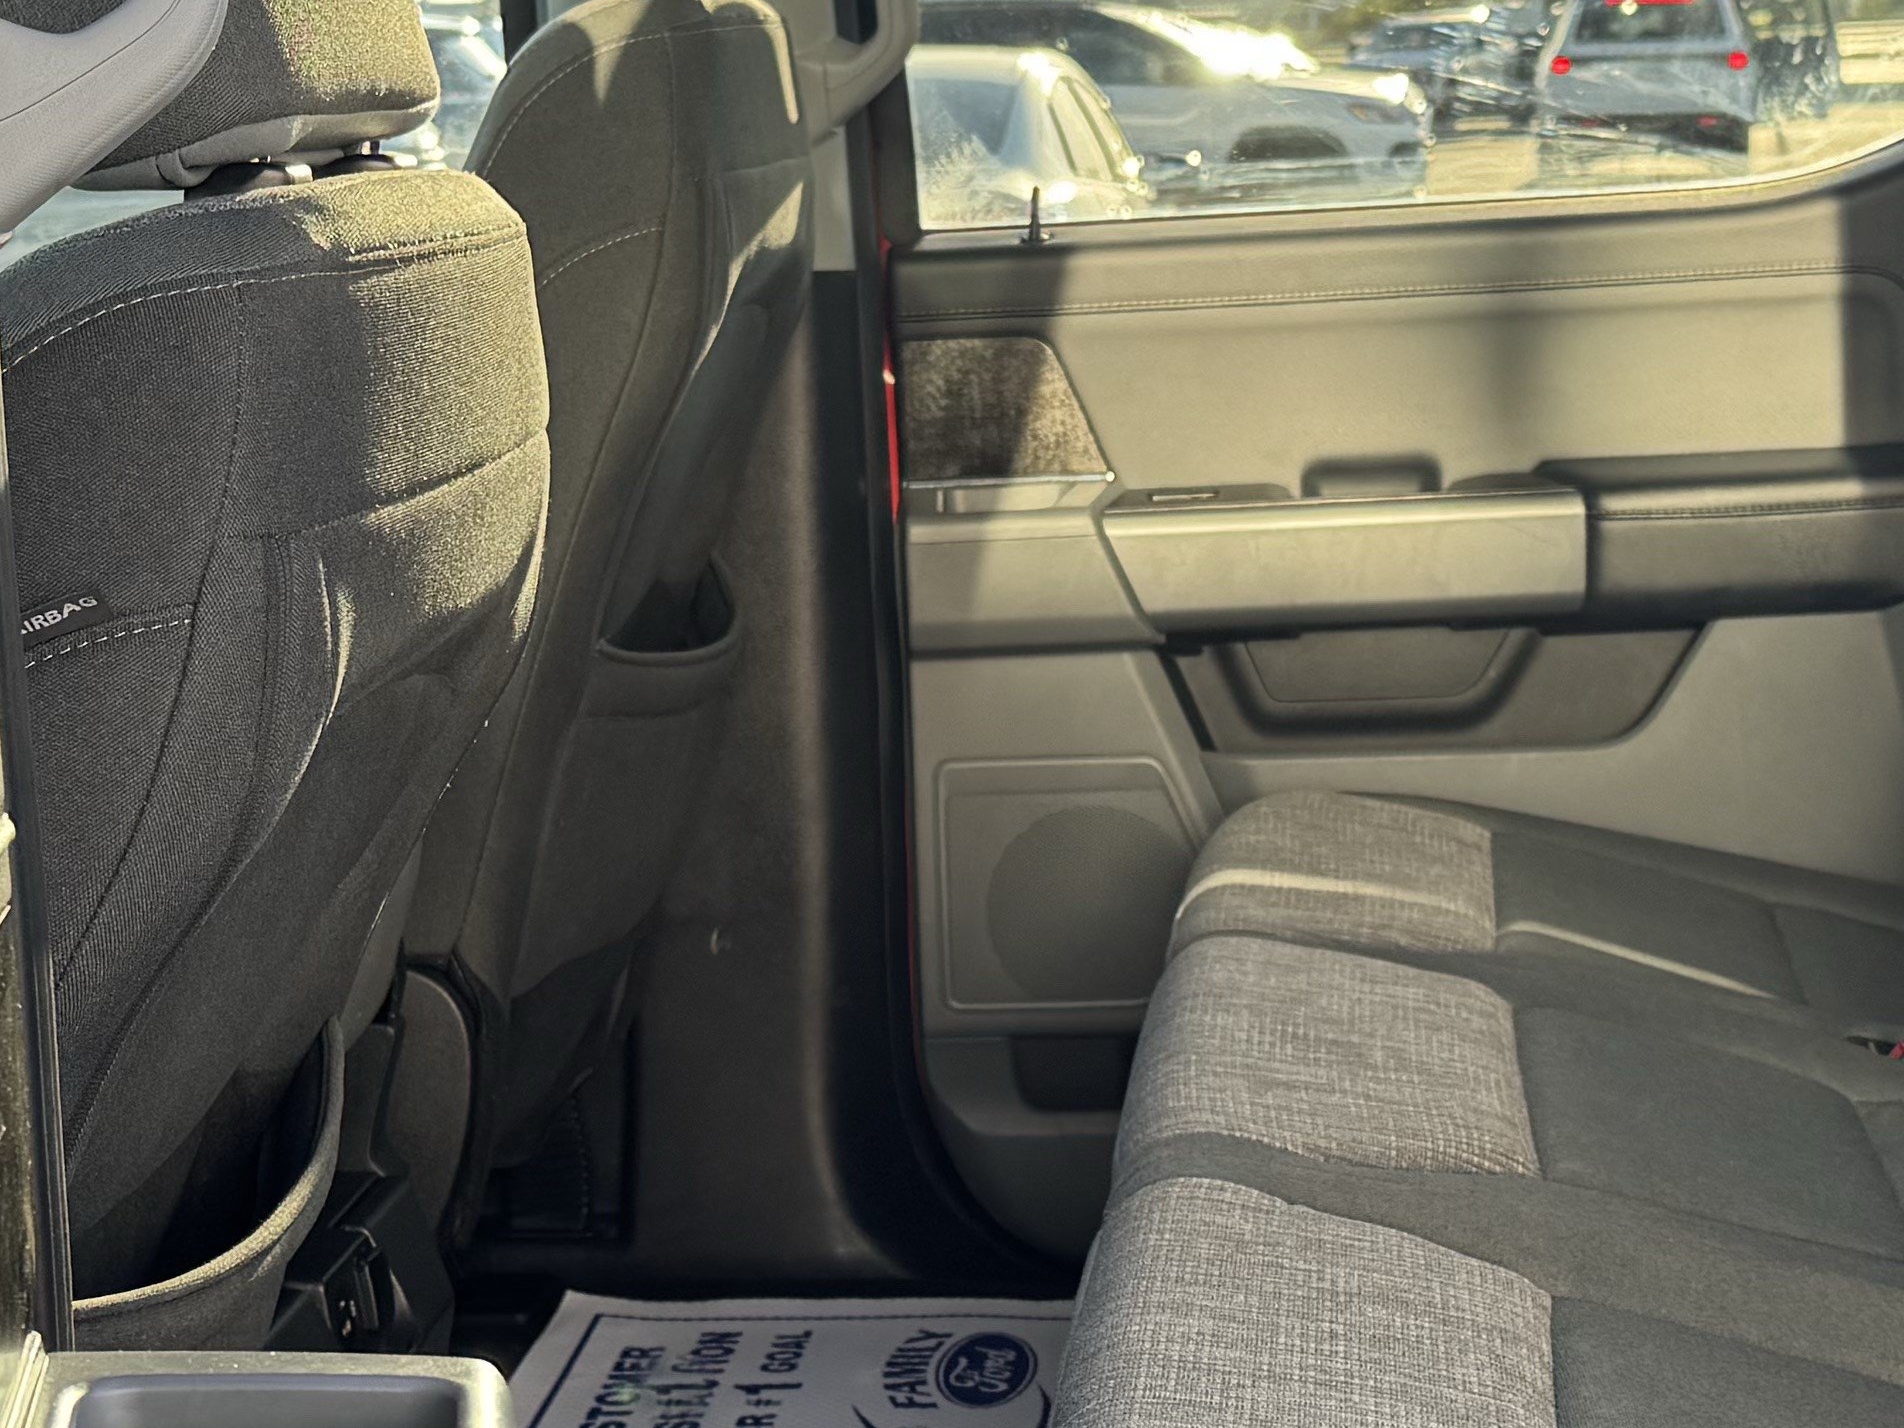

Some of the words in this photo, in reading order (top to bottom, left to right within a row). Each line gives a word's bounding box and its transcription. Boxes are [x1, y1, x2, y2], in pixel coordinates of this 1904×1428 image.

[20, 595, 98, 635] IRBAG
[760, 1330, 813, 1373] GOAL
[881, 1329, 954, 1410] FAMILY
[948, 1346, 1018, 1393] Ford
